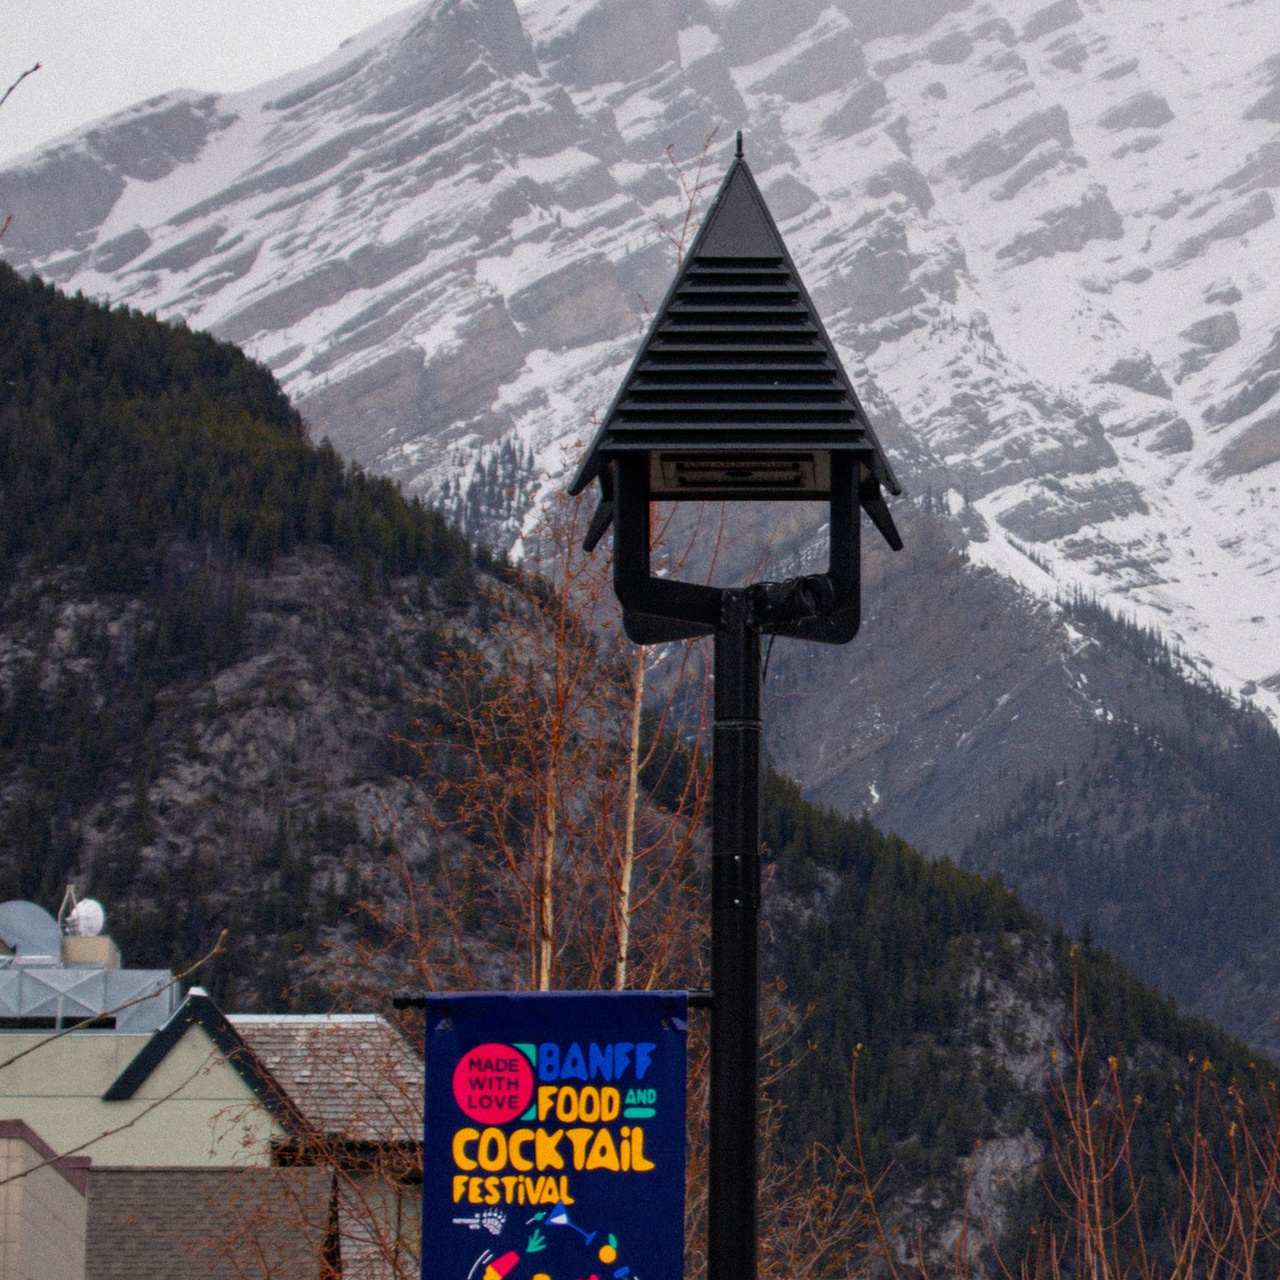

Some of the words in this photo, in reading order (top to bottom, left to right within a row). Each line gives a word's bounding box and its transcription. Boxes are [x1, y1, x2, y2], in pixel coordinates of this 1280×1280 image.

[468, 1058, 519, 1072] MADE
[538, 1042, 657, 1082] BANFF
[468, 1077, 519, 1090] WITH
[467, 1095, 519, 1109] LOVE
[537, 1086, 620, 1123] FOOD
[625, 1088, 656, 1105] AND
